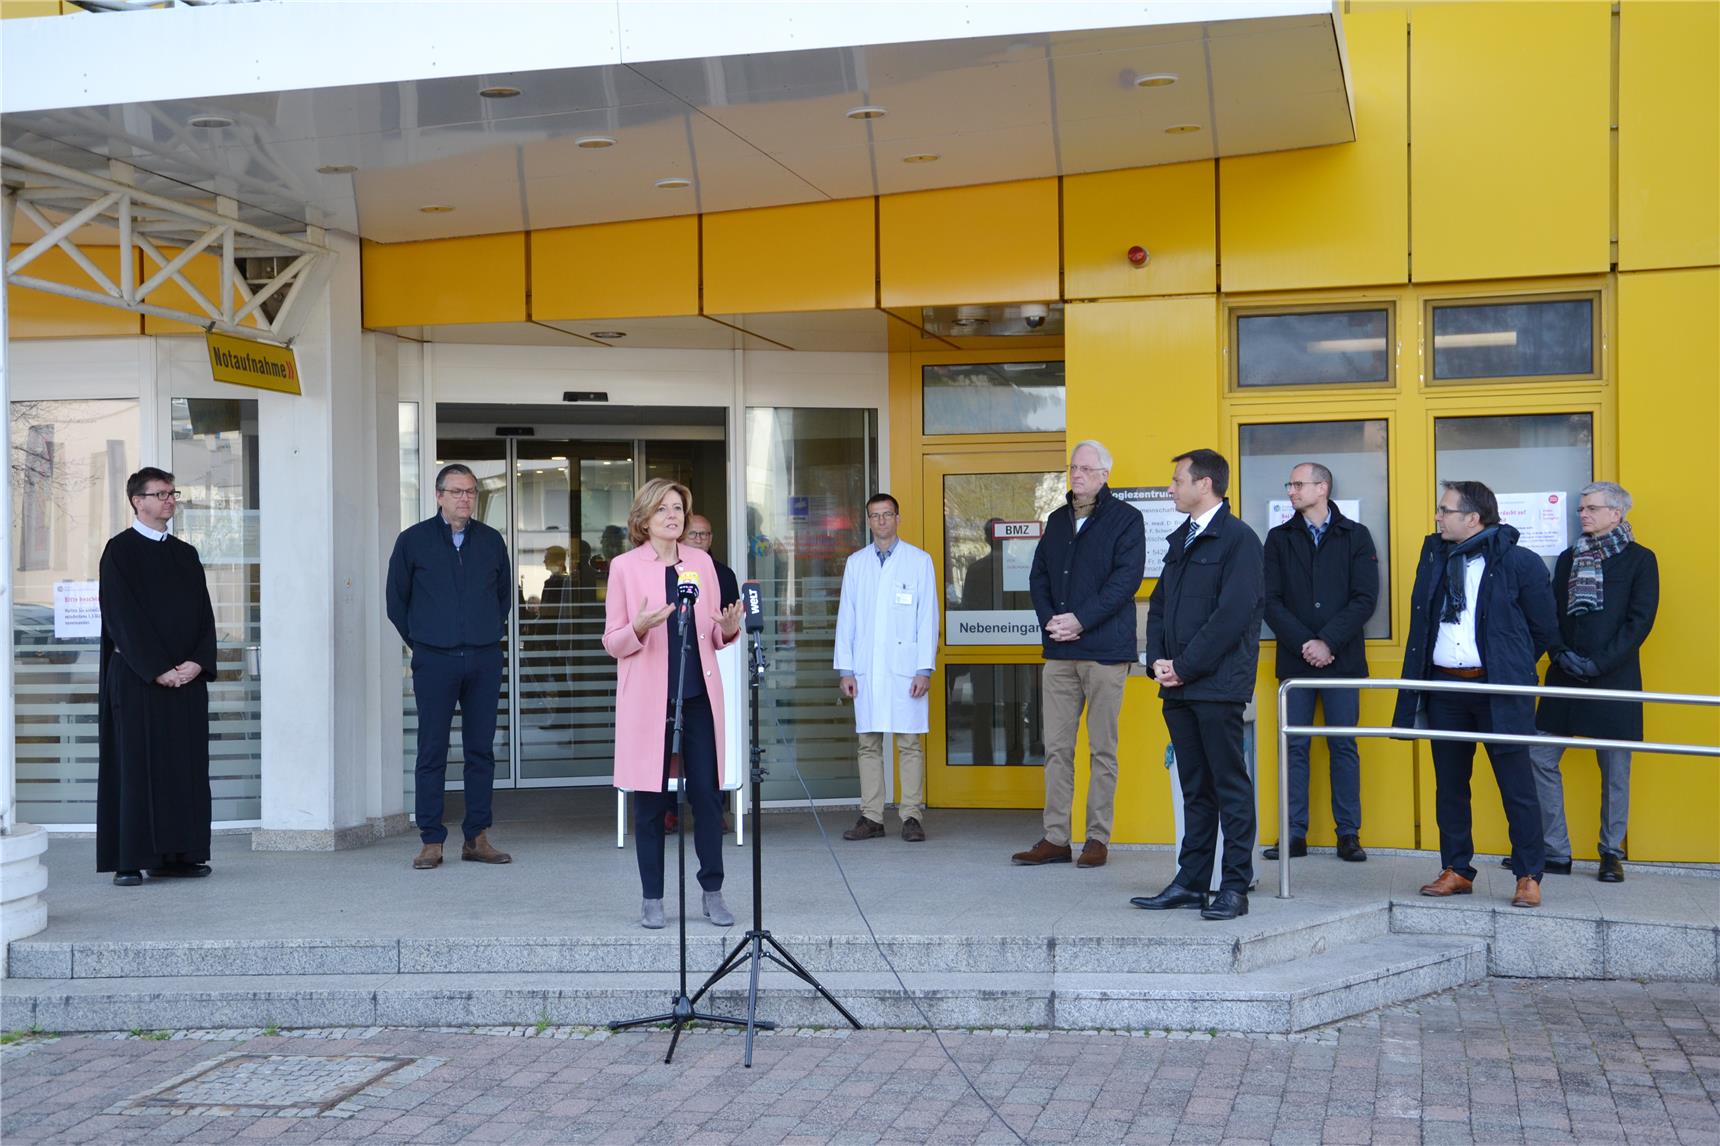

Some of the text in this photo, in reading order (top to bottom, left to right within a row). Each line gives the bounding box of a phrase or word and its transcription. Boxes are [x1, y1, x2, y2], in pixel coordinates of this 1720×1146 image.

[213, 346, 287, 379] Notaufnahme
[1110, 490, 1174, 501] ogiezentru
[1005, 525, 1030, 535] BMZ
[959, 622, 1040, 635] Nebeneinga
